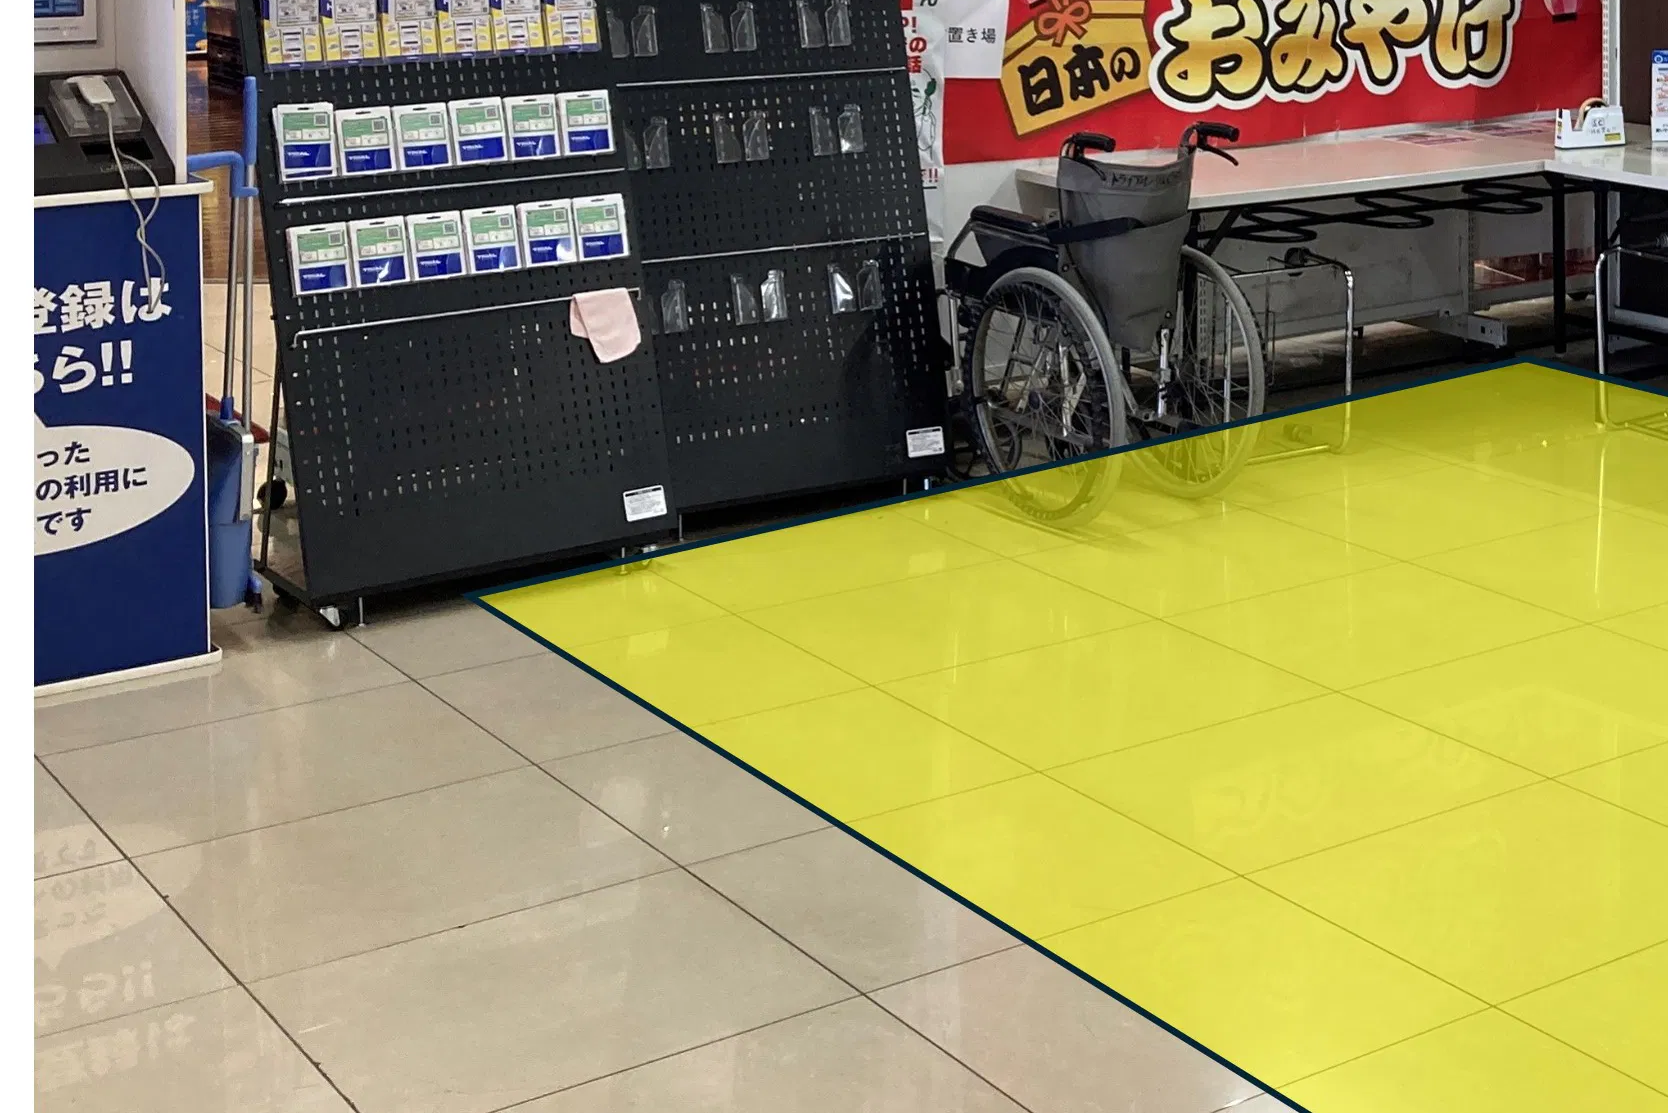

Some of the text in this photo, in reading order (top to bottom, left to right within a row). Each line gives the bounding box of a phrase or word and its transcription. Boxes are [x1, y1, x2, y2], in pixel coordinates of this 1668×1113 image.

[947, 26, 996, 45] 置き場
[1018, 45, 1142, 115] 日本の
[37, 441, 90, 468] った
[35, 467, 147, 501] の利用に
[37, 507, 92, 535] です
